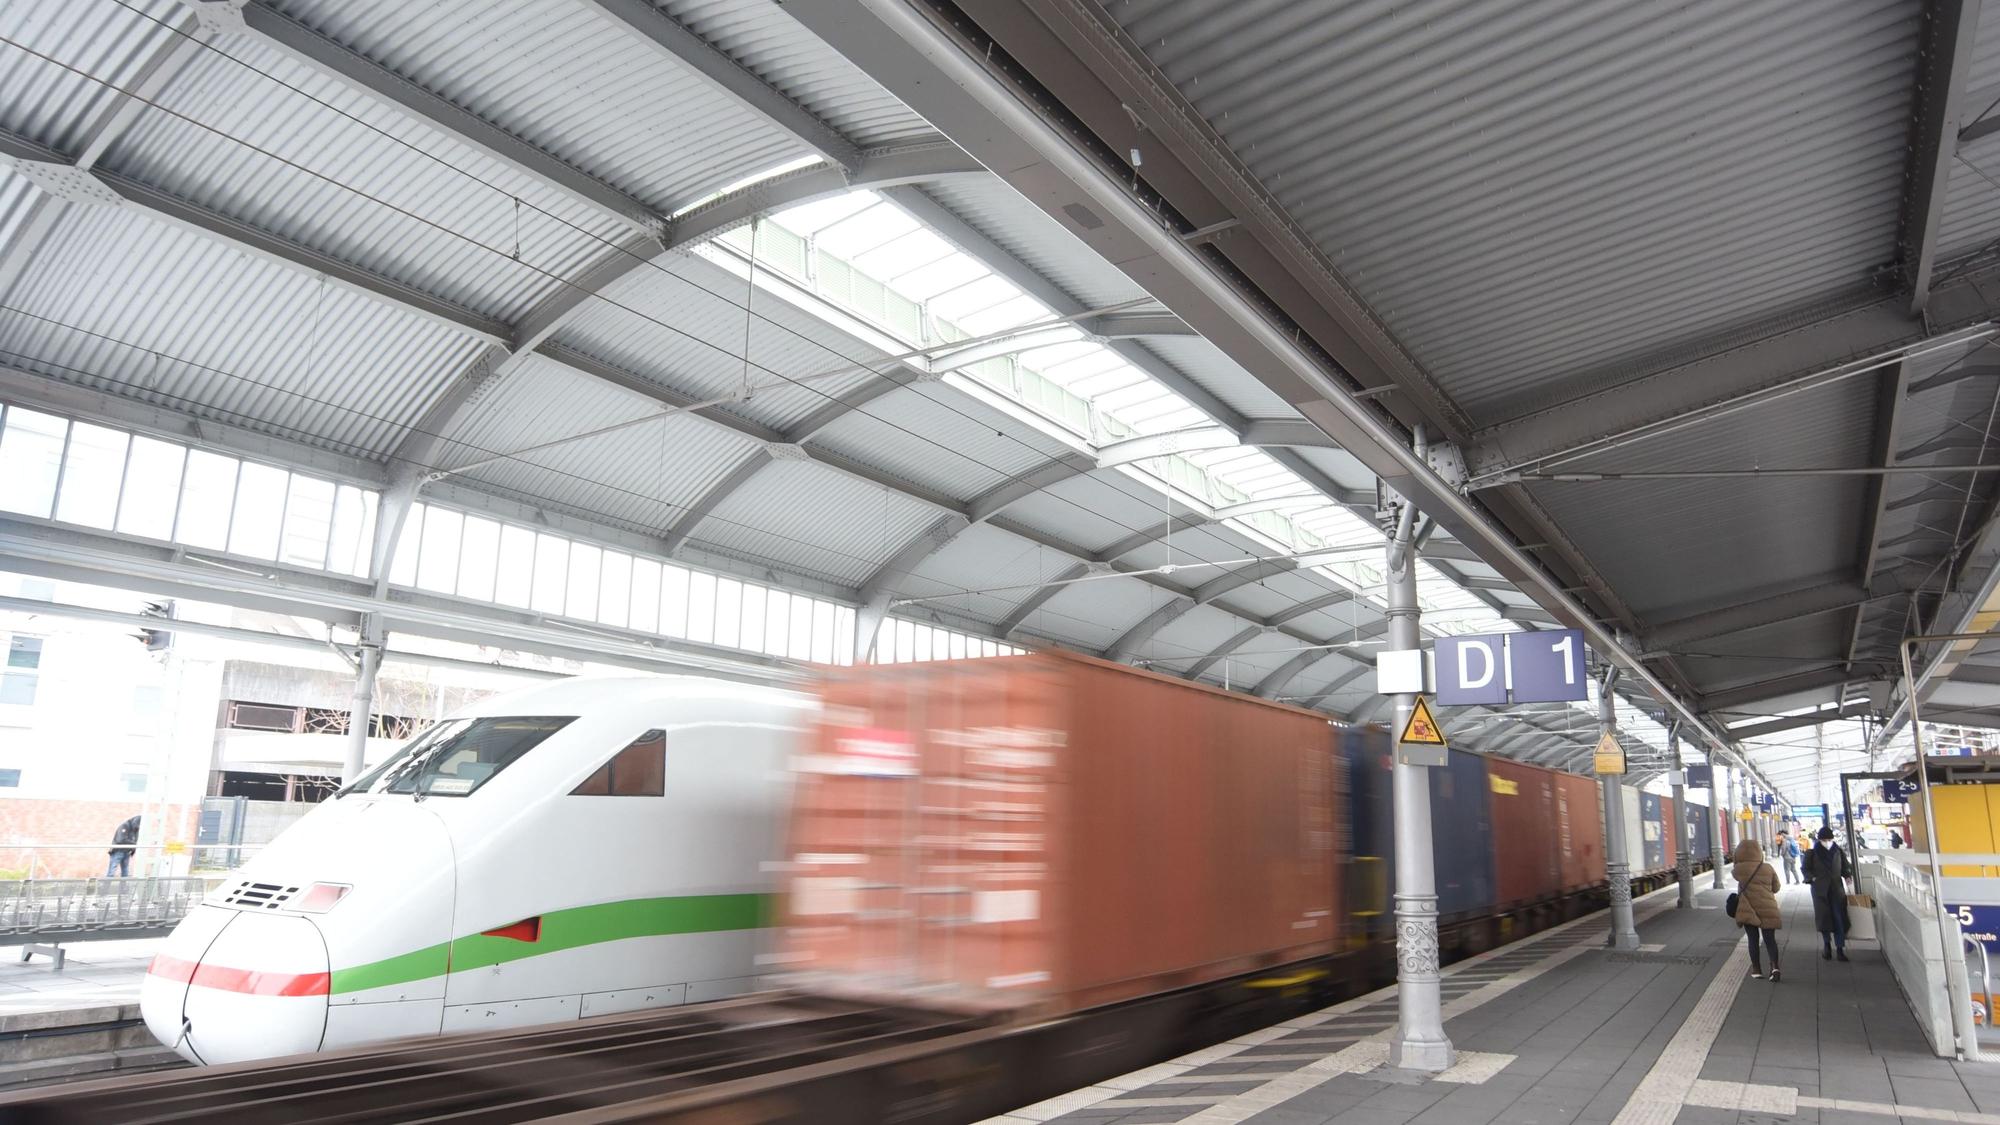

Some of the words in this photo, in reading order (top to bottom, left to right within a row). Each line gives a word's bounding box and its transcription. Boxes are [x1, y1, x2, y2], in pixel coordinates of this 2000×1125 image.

[1457, 640, 1495, 689] D
[1551, 636, 1575, 685] 1
[1898, 781, 1918, 791] 2-5
